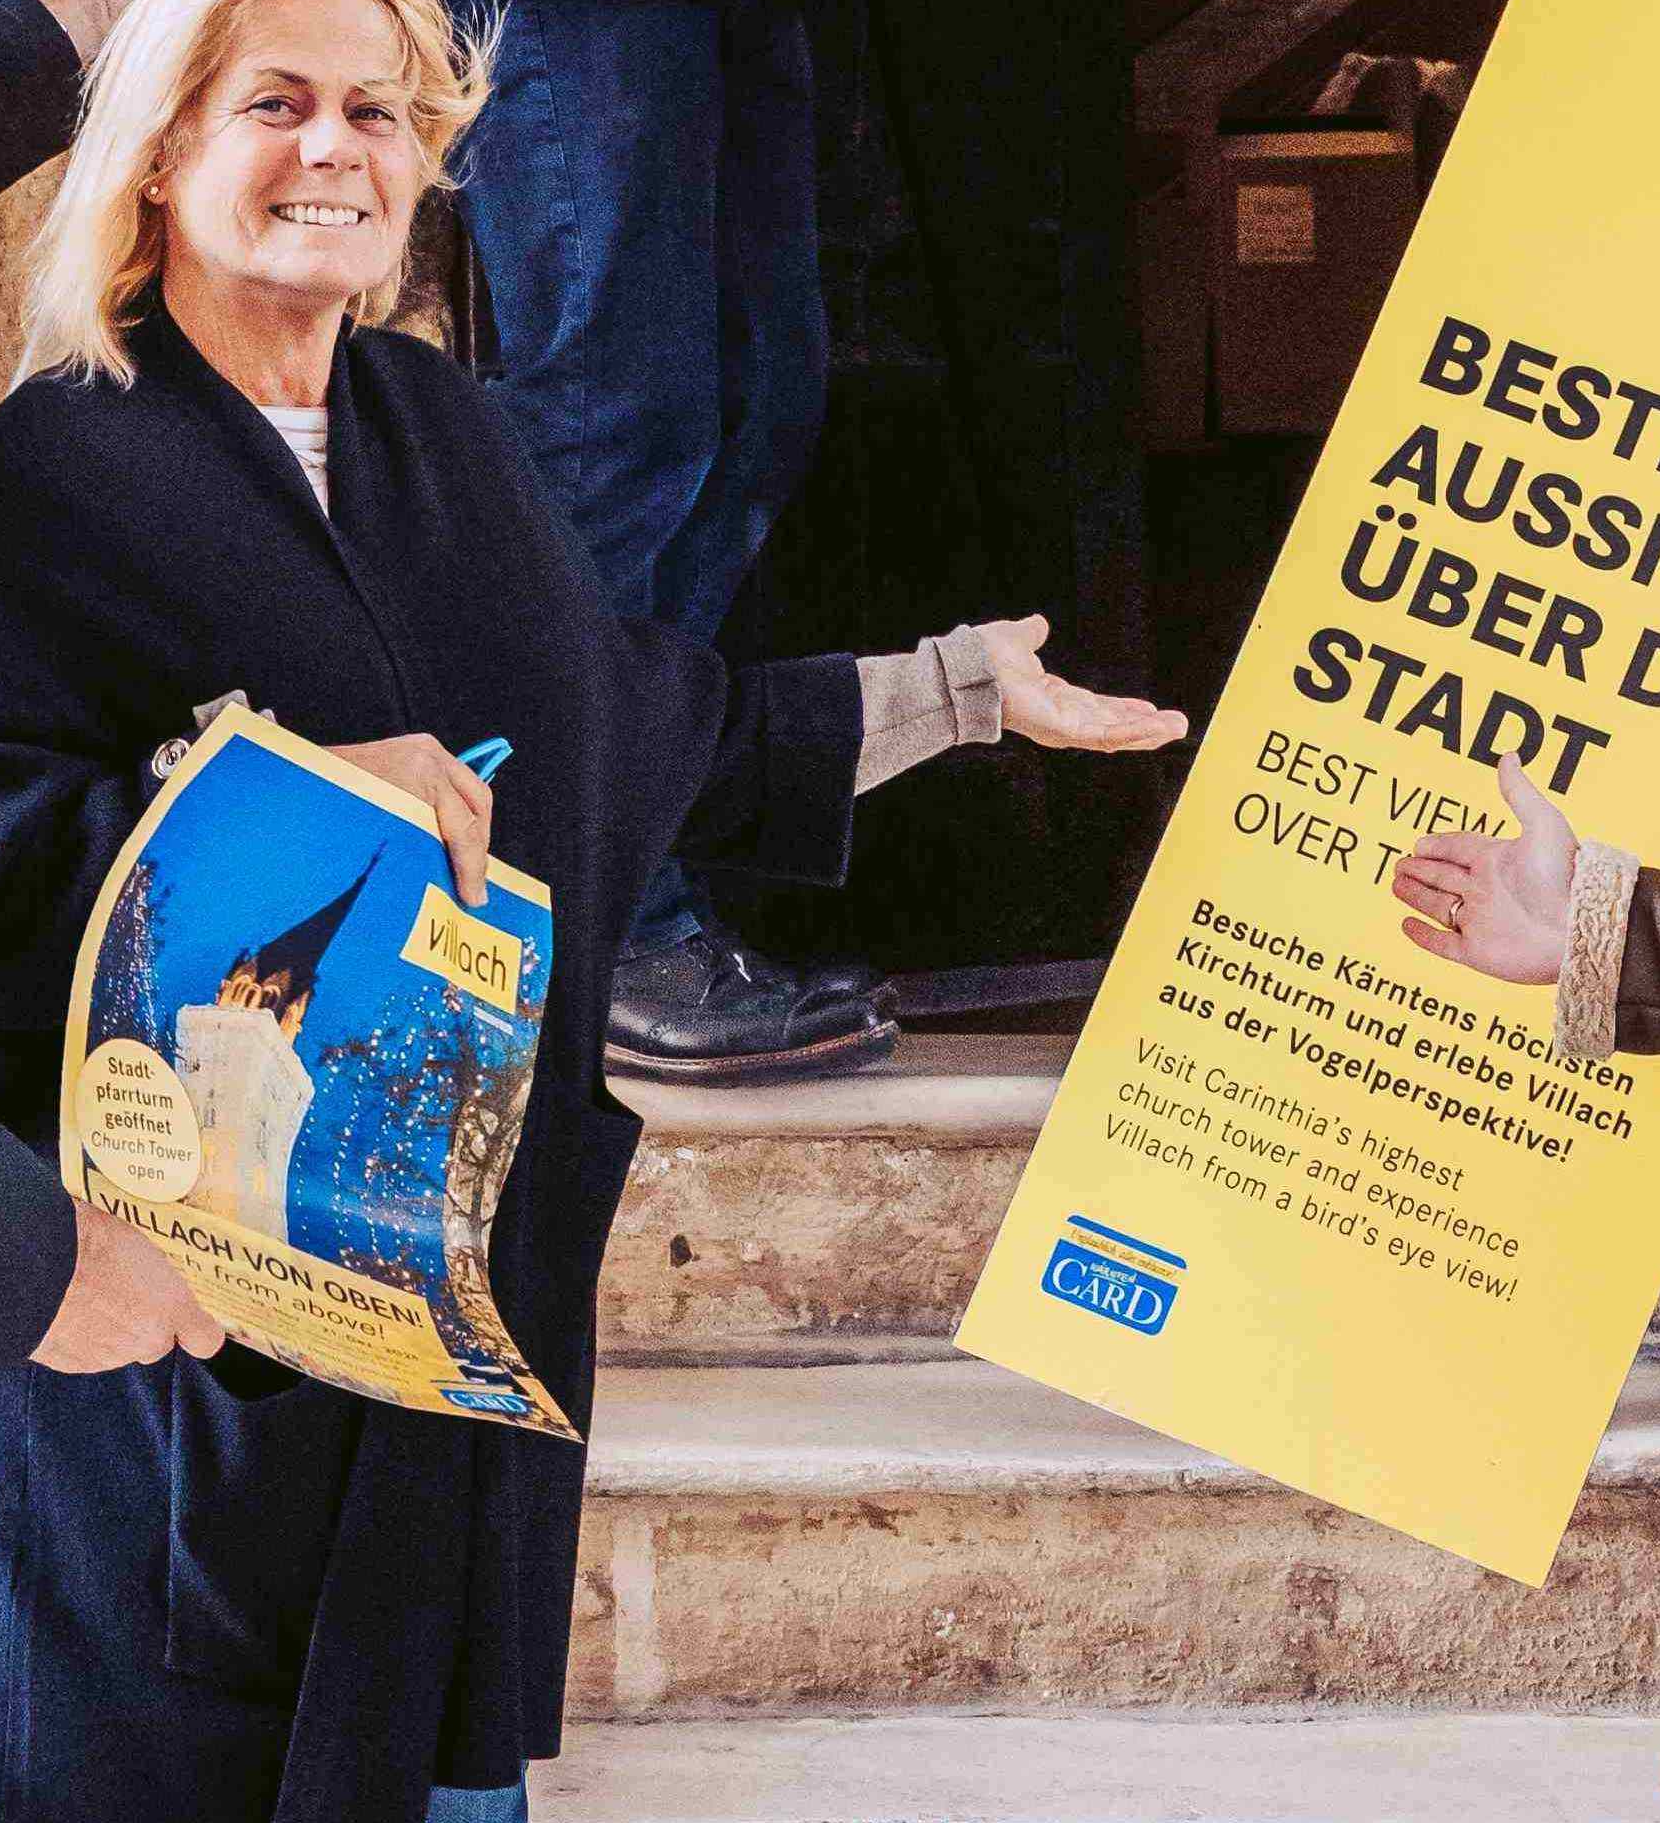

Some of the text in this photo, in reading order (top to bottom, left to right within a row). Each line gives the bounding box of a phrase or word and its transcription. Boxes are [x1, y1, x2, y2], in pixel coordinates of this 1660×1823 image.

[1341, 505, 1603, 682] ÜBER
[1293, 628, 1611, 795] STADT
[1256, 731, 1377, 804] BEST
[1235, 794, 1357, 872] OVER
[430, 918, 506, 991] villach
[1192, 899, 1323, 970] Besuche
[1335, 955, 1476, 1031] Kärntens
[108, 1056, 155, 1079] Stadt-
[1159, 985, 1573, 1162] aus der Vogelperspektive!
[1176, 937, 1632, 1139] Kirchturm und erlebe Villach
[96, 1082, 173, 1109] pfarrturm
[105, 1111, 172, 1136] geöffnet
[1139, 1038, 1196, 1083] Visit
[1361, 1130, 1463, 1191] highest
[91, 1130, 192, 1162] Church Tower
[127, 1163, 165, 1181] open
[1119, 1083, 1518, 1257] church tower and experience
[1108, 1114, 1193, 1170] Villach
[1204, 1156, 1266, 1200] from
[1276, 1192, 1291, 1210] a
[1389, 1238, 1434, 1268] eye
[1447, 1259, 1517, 1301] view!
[99, 1192, 234, 1262] VILLACH
[243, 1246, 313, 1293] VON
[323, 1279, 426, 1328] OBEN!
[1052, 1257, 1163, 1325] CARD
[213, 1264, 281, 1302] from
[292, 1296, 386, 1341] above!
